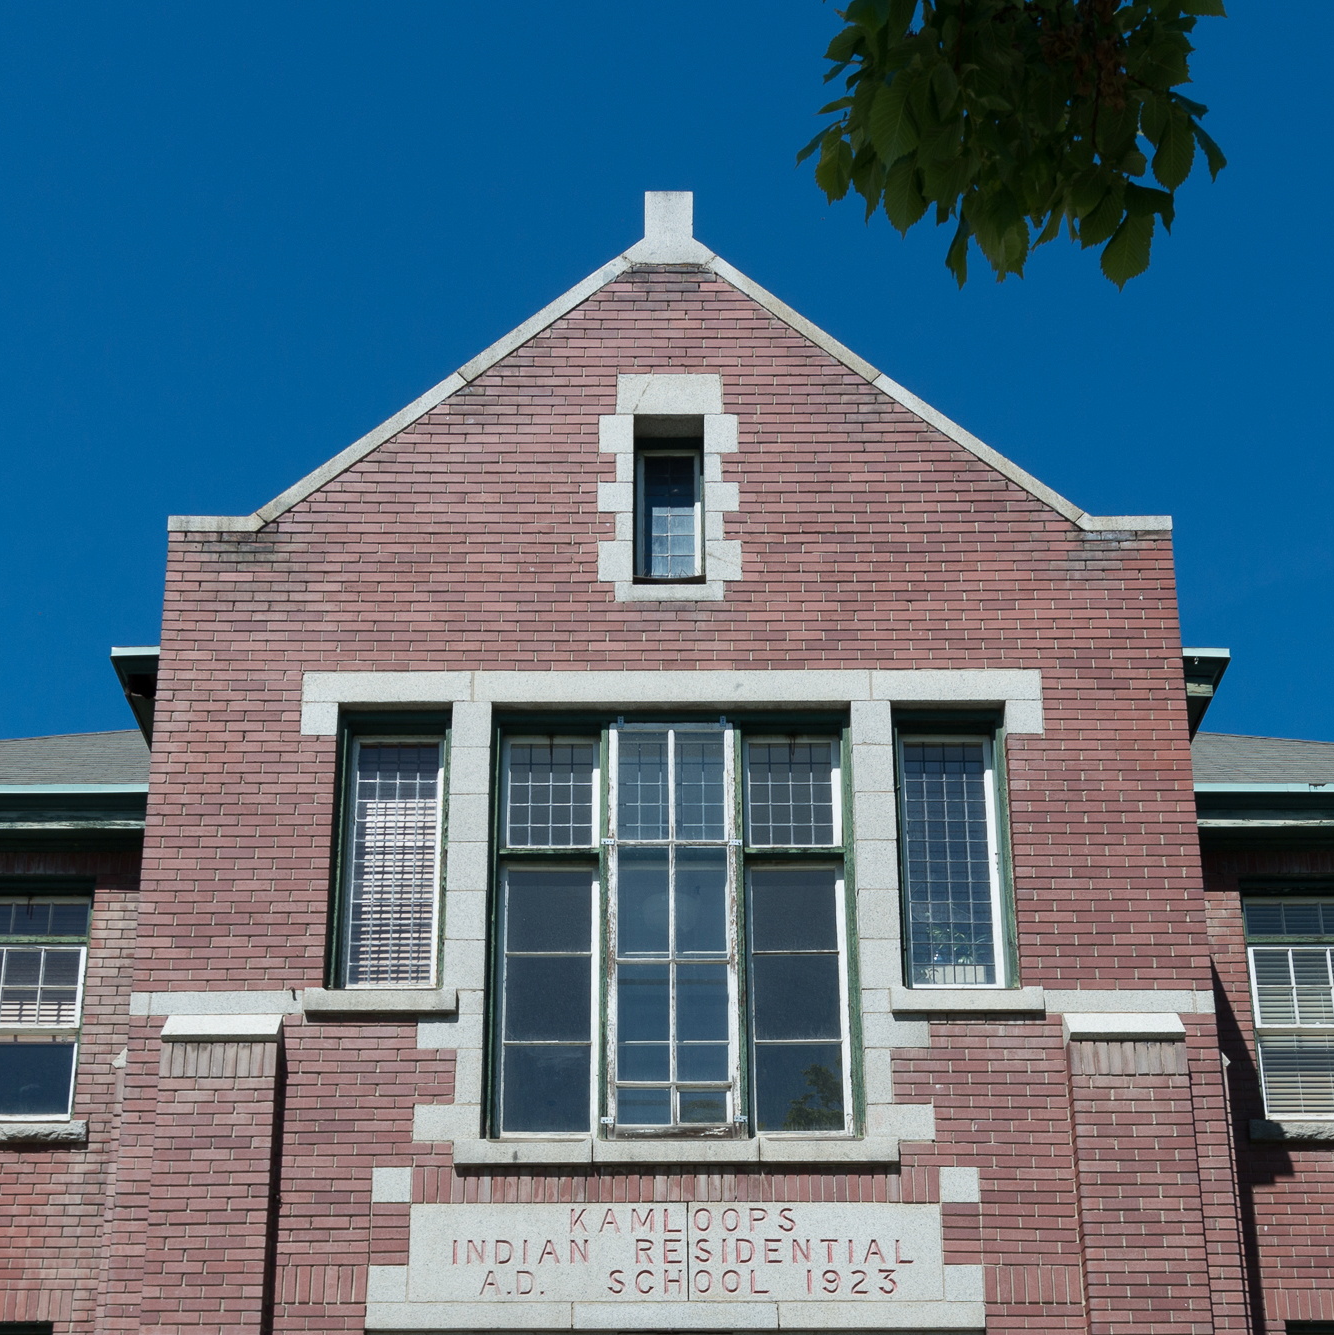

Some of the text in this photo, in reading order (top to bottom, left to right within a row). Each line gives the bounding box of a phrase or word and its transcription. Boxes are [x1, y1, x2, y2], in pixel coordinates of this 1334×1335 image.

[569, 1206, 797, 1234] KAMLOOPS
[451, 1238, 915, 1266] INDIAN RESIDENTIAL
[479, 1268, 899, 1296] A.D. SCHOOL 1923
